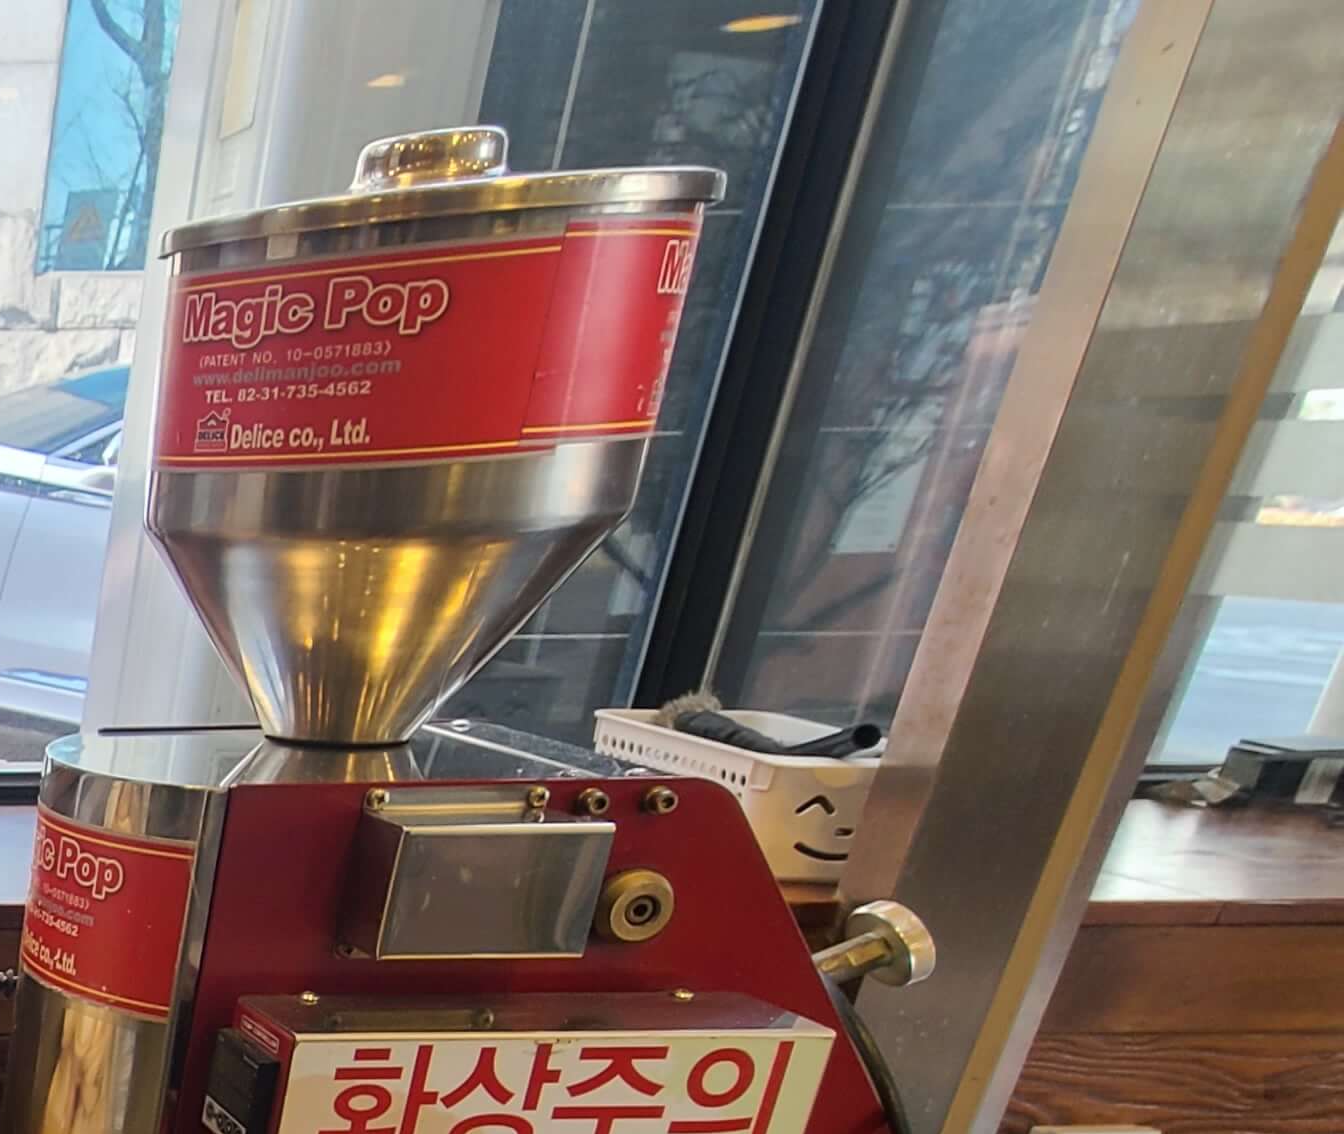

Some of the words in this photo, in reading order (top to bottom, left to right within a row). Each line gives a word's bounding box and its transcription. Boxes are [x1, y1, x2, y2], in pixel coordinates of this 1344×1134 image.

[183, 285, 315, 349] Magic
[324, 276, 449, 334] Pop
[253, 350, 278, 364] NO.
[205, 389, 233, 405] TEL.
[238, 381, 371, 402] 82-31-735-4562
[231, 423, 284, 449] Delice
[330, 418, 370, 445] Ltd.
[57, 836, 124, 899] Pop
